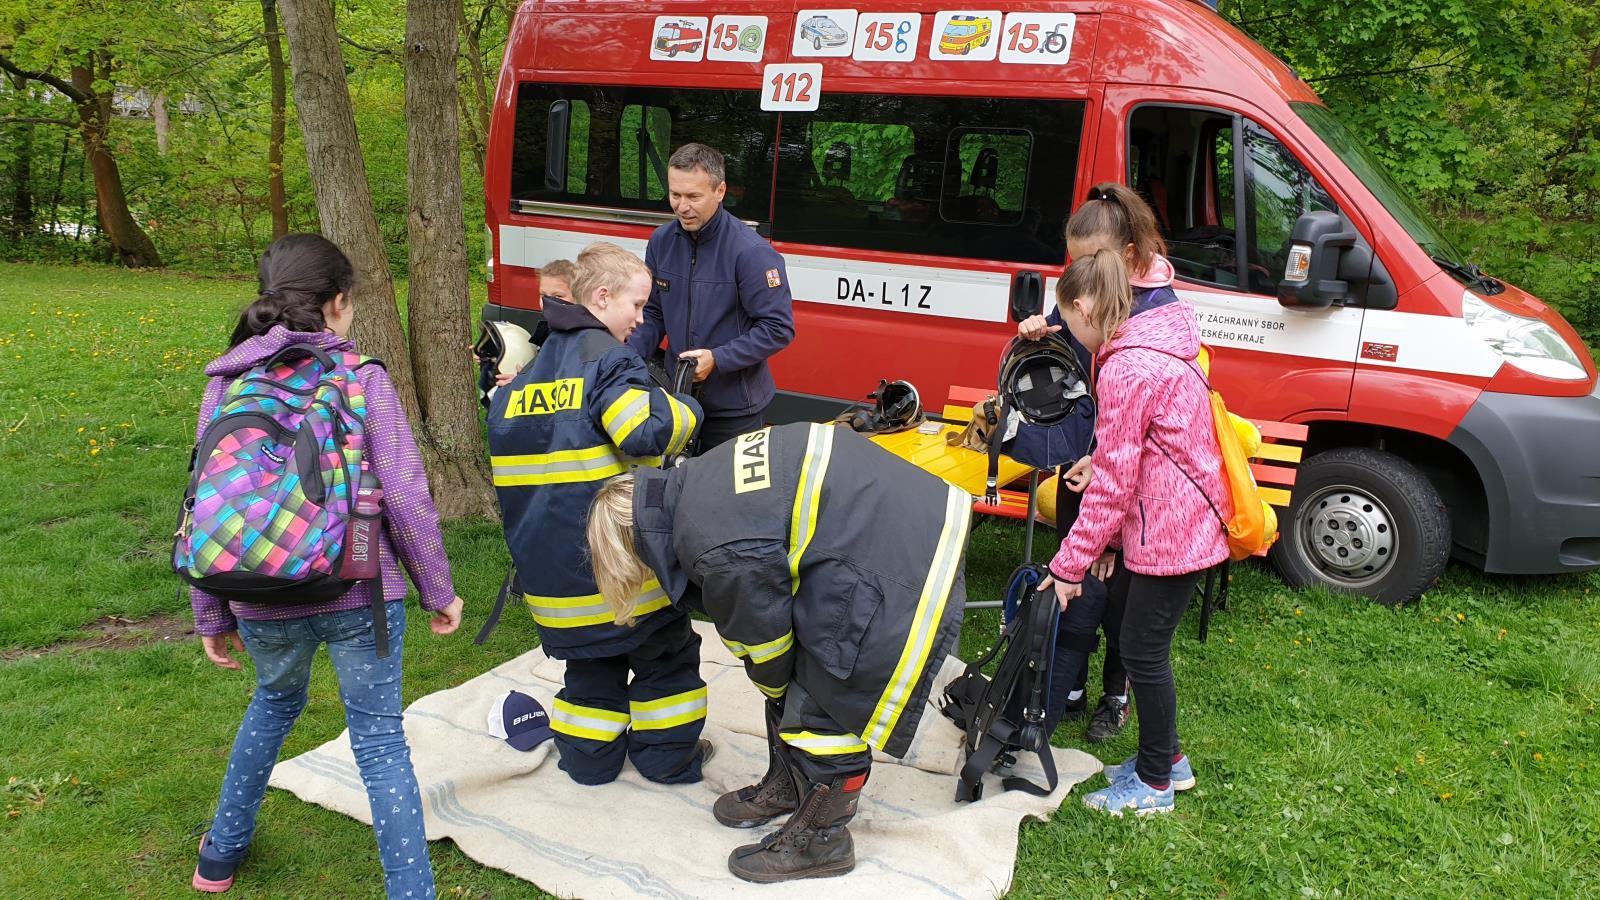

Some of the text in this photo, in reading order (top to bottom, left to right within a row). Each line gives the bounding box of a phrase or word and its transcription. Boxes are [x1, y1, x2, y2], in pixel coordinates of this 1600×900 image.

[771, 72, 813, 102] 112
[1199, 328, 1265, 345] ESKÉHO KRAJE
[1207, 312, 1259, 328] ZÁCHRANNÝ
[1261, 320, 1285, 332] SBOR
[742, 431, 766, 485] HAS
[352, 522, 369, 562] 1977
